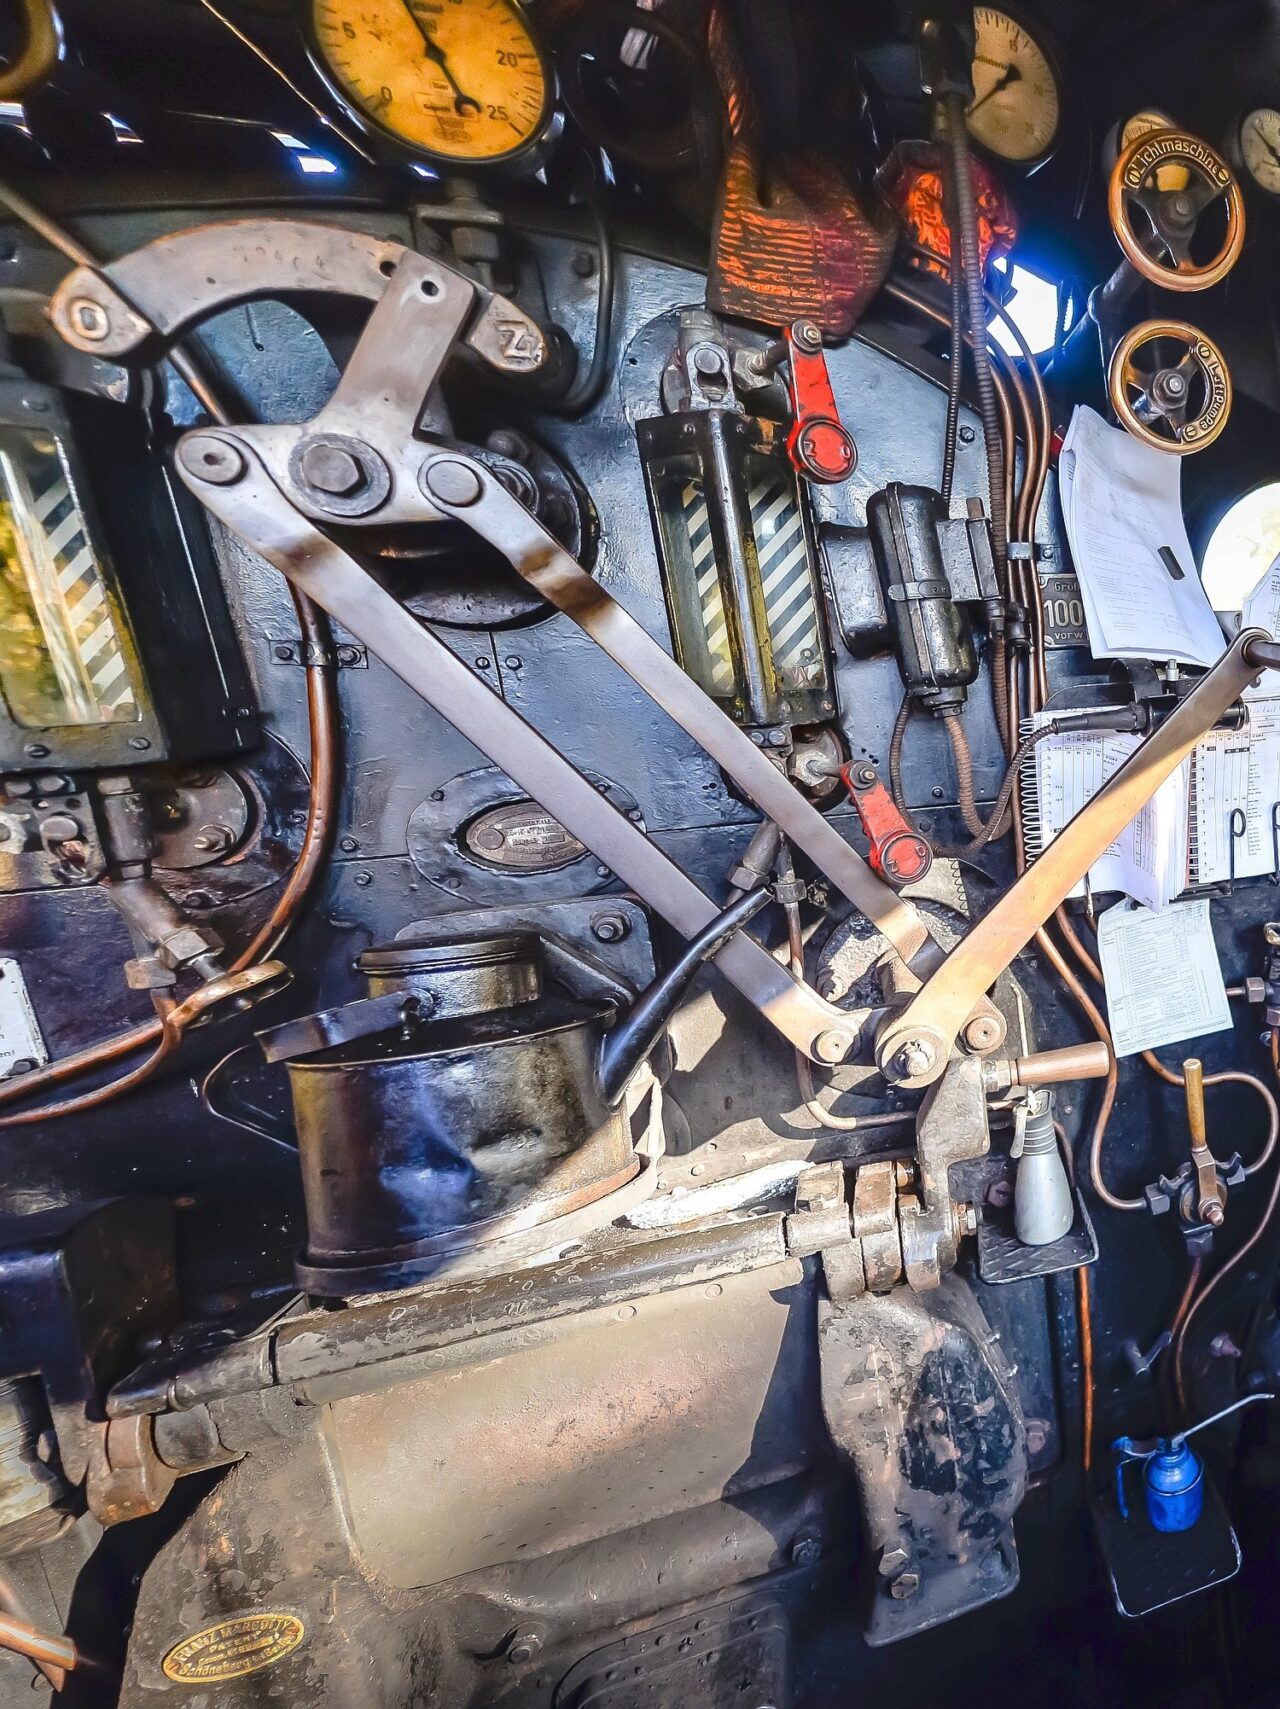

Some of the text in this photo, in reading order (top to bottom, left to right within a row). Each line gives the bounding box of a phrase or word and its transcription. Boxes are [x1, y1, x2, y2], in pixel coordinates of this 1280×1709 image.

[342, 22, 355, 39] 5
[1009, 39, 1018, 53] 15
[496, 50, 518, 68] 20
[380, 86, 392, 102] 0
[1033, 83, 1043, 97] 20
[486, 104, 509, 121] 25
[1025, 122, 1034, 136] 25
[1135, 139, 1219, 175] Lichtmaschine
[1200, 361, 1225, 430] Luftpumpe
[1043, 599, 1084, 628] 100
[173, 1631, 220, 1662] FRANZ
[178, 1656, 250, 1677] Schöneberg
